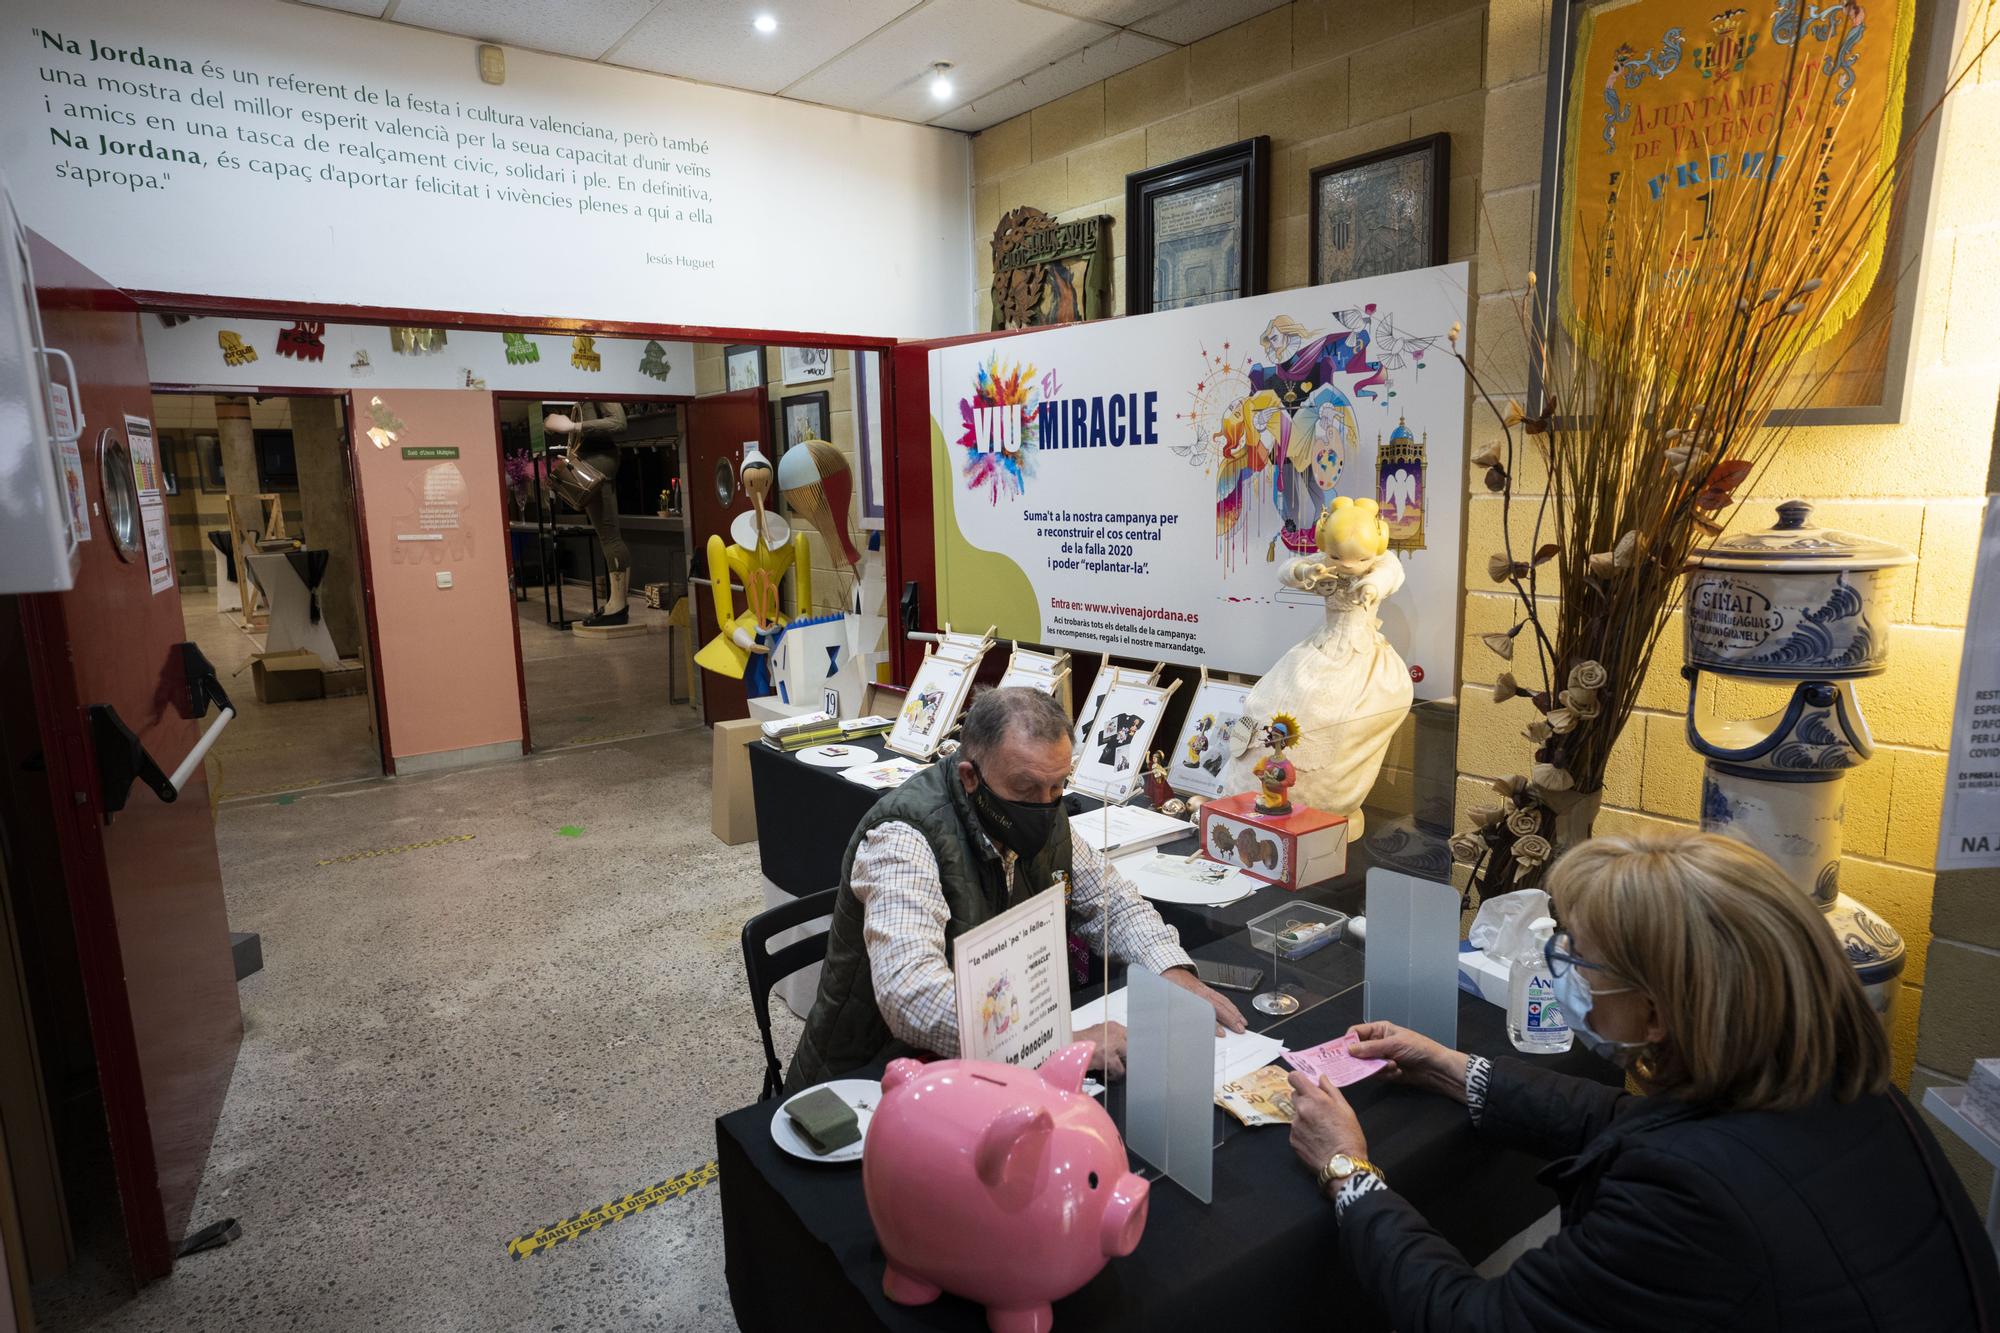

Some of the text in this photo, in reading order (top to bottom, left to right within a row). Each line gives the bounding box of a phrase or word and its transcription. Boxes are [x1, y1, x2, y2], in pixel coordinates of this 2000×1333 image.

[90, 39, 194, 74] Jordana
[201, 60, 225, 80] és
[233, 69, 259, 86] un
[268, 73, 348, 100] referent
[354, 85, 379, 105] de
[386, 89, 400, 108] la
[407, 93, 451, 116] festa
[456, 102, 460, 117] i
[467, 105, 524, 128] cultura
[530, 116, 618, 143] valenciana,
[623, 132, 658, 148] però
[663, 135, 709, 155] també
[40, 67, 711, 178] una mostra del millor esperit valencià per la seua capacitat d'unir veïns
[1634, 106, 1804, 160] DE VALÈNCA
[44, 94, 51, 113] i
[64, 104, 136, 126] amics
[146, 115, 175, 132] en
[187, 122, 227, 139] una
[237, 125, 295, 148] tasca
[303, 134, 330, 152] de
[339, 142, 447, 168] realçament
[506, 163, 565, 183] solidari
[572, 170, 576, 184] i
[583, 172, 611, 191] ple.
[618, 176, 636, 192] En
[642, 179, 713, 203] definitiva,
[50, 127, 713, 224] Na Jordana, és capaç d'aportar felicitat i vivències plenes a qui a ella
[55, 160, 171, 192] s'apropa."
[646, 252, 715, 270] Jesús Huguet
[1041, 368, 1063, 399] EL
[973, 403, 1021, 454] VIU
[1039, 391, 1158, 450] MIRACLE
[1023, 510, 1178, 526] Suma't a la nostra campanya per
[1037, 527, 1161, 541] a reconstruir el cos central
[1061, 542, 1133, 556] de la falla 2020
[1047, 557, 1051, 568] i
[1052, 558, 1079, 571] poder
[1051, 598, 1199, 623] Entra en: www.vivenajordana.es
[1047, 626, 1056, 634] les
[1056, 628, 1098, 641] recompenses,
[1099, 633, 1119, 643] regals
[1124, 634, 1130, 644] el
[1131, 637, 1153, 647] nostre
[1154, 639, 1206, 655] marxandatge.
[1091, 620, 1104, 629] tots
[1105, 621, 1114, 630] els
[1115, 622, 1137, 633] detalls
[1138, 625, 1148, 634] de
[1149, 626, 1155, 635] la
[1156, 629, 1197, 641] campanya:
[825, 692, 836, 716] 19
[1974, 704, 2000, 715] ESPE
[1971, 734, 1989, 743] PER
[1968, 771, 1993, 780] PREGA
[1961, 836, 1990, 852] NA
[981, 940, 1008, 961] voluntat
[1021, 1027, 1053, 1061] donacions
[535, 1212, 605, 1245] MANTENGA
[608, 1205, 624, 1217] LA
[628, 1181, 688, 1209] DISTANCIA
[690, 1173, 707, 1184] DE
